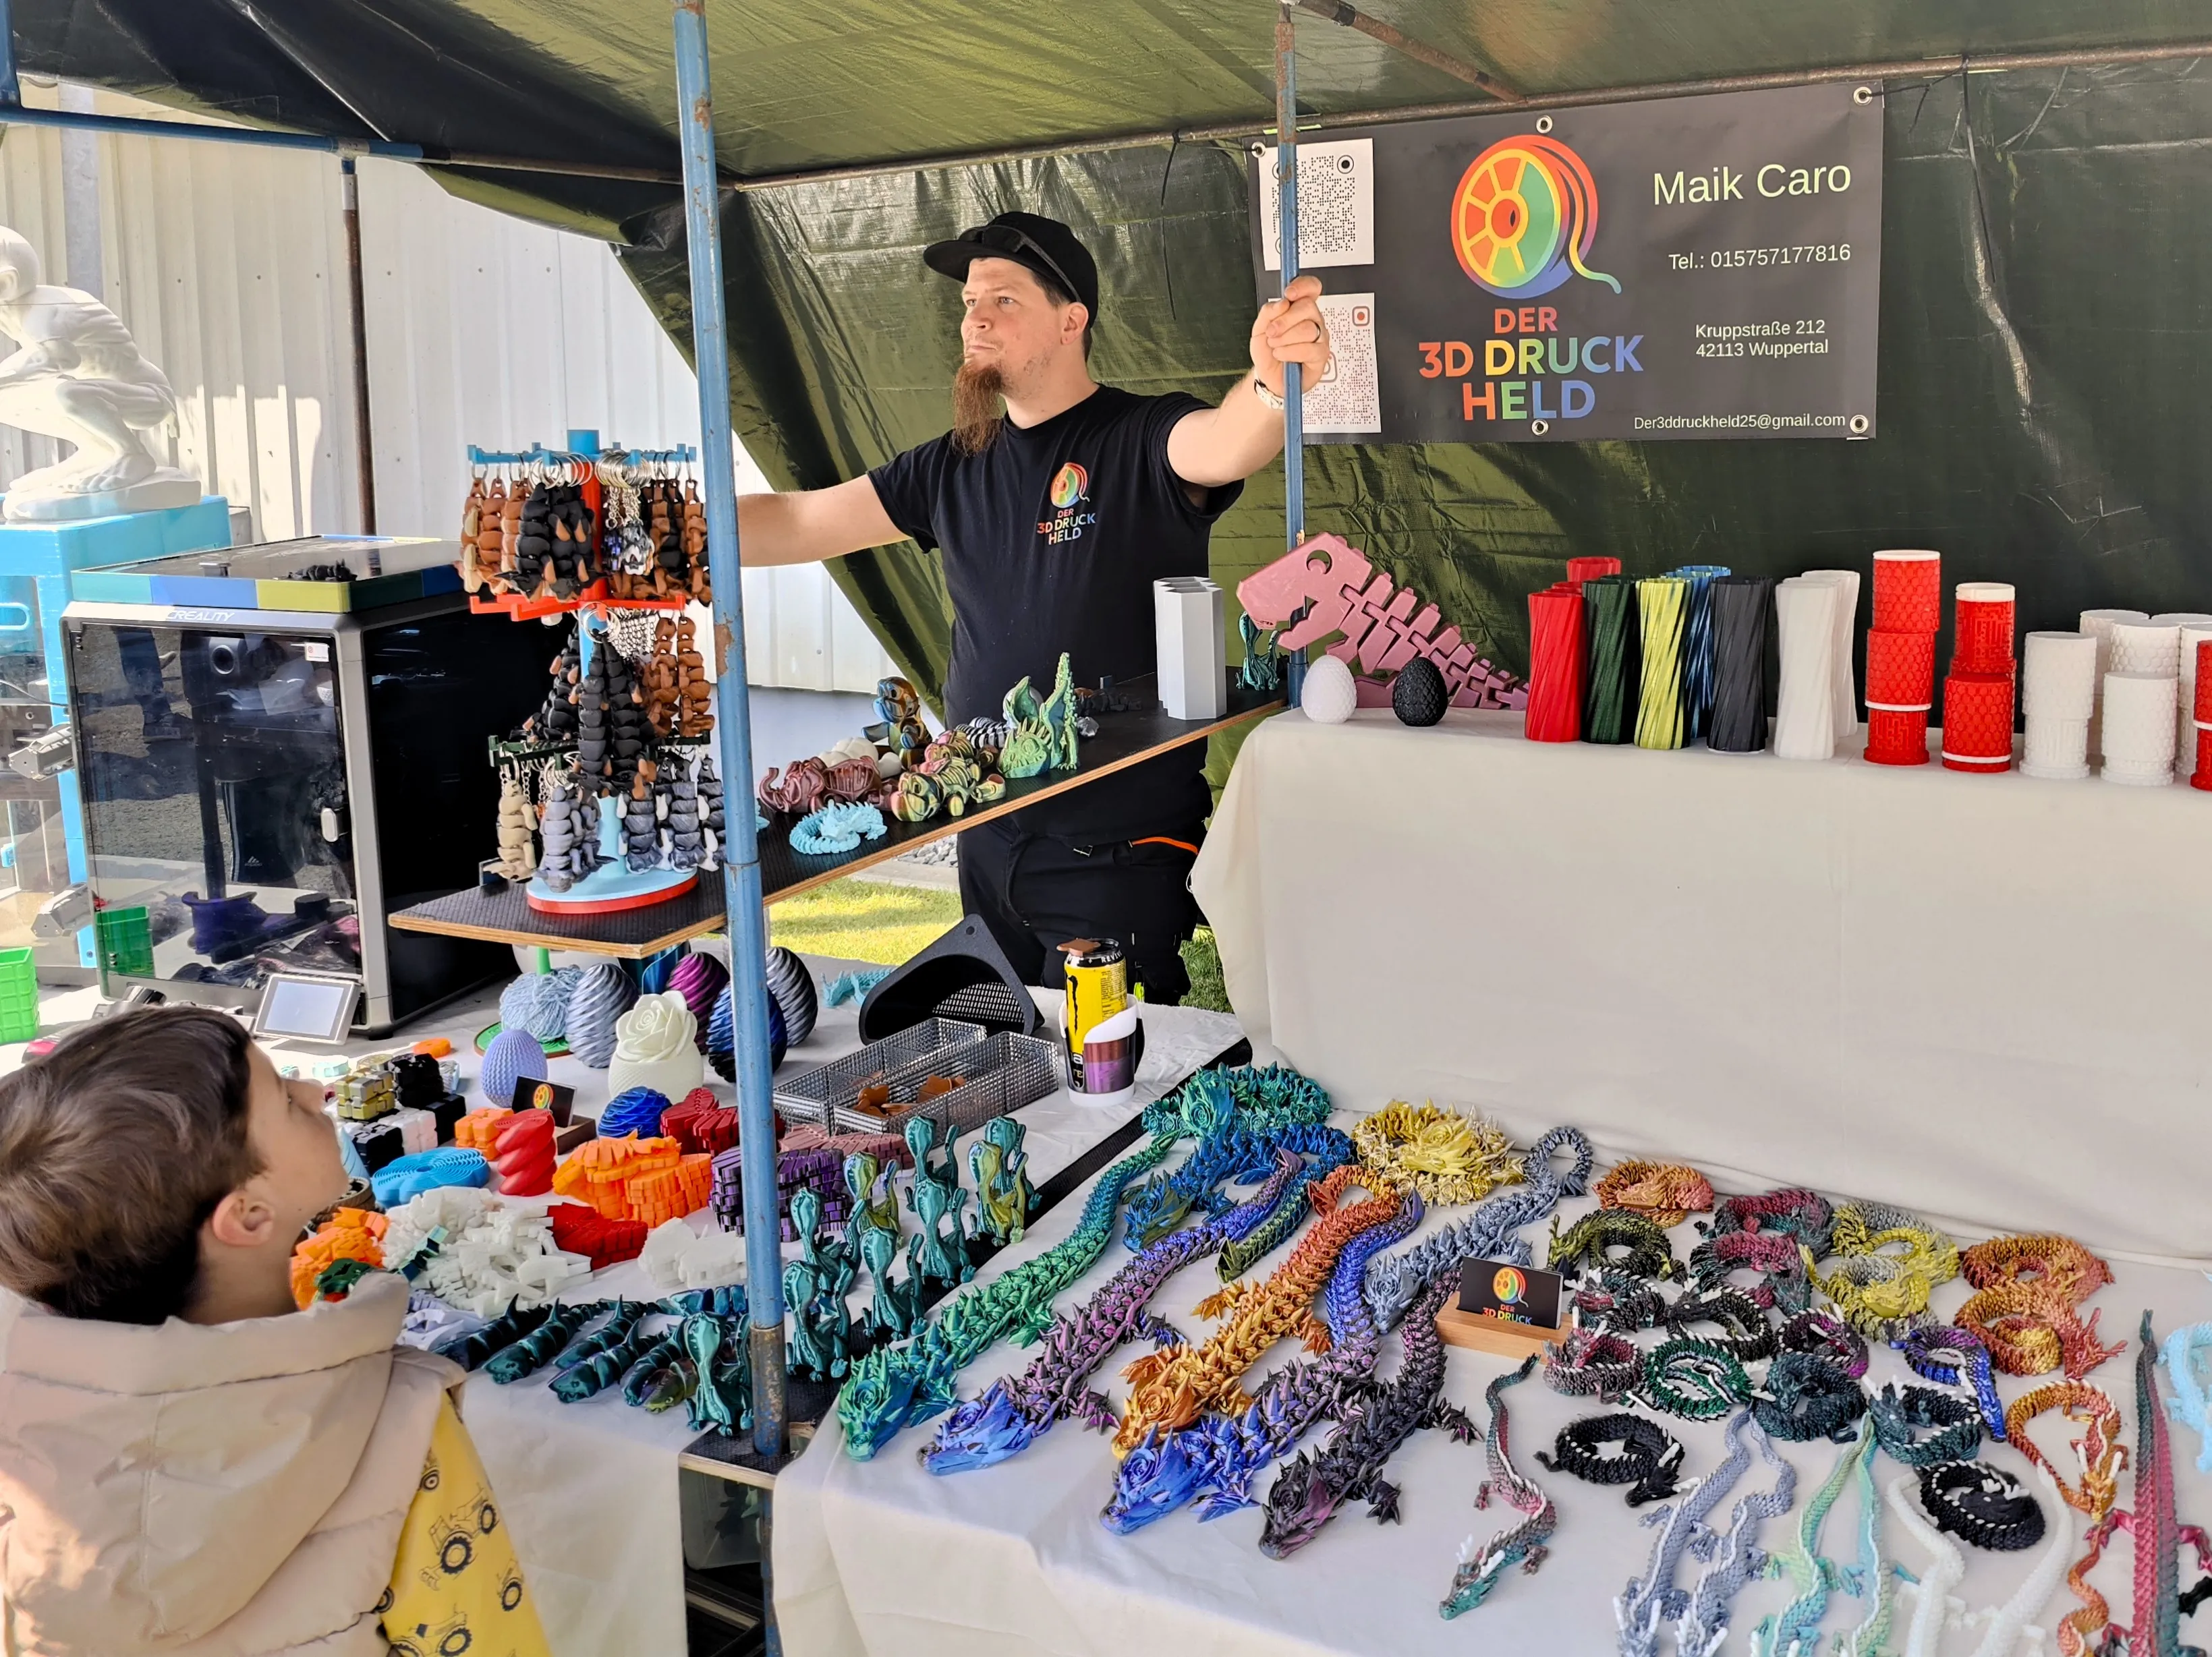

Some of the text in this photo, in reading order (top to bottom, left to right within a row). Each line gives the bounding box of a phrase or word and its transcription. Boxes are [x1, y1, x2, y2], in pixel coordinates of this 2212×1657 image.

[1654, 164, 1851, 205] Maik Caro
[1668, 243, 1851, 270] Tel.: 015757177816
[1494, 307, 1558, 334] DER
[1695, 320, 1825, 341] Kruppstraße 212
[1419, 335, 1645, 378] 3D DRUCK
[1696, 339, 1829, 359] 42113 Wuppertal
[1463, 380, 1596, 421] HELD
[1634, 413, 1846, 430] Der3ddruckheld25@gmail.com
[1037, 513, 1096, 534] 3D DRUCK
[1057, 508, 1074, 519] DER
[1048, 527, 1081, 545] HELD
[167, 610, 235, 621] CREALITY
[1483, 1307, 1532, 1325] 3D DRUCK
[1500, 1304, 1515, 1312] DER
